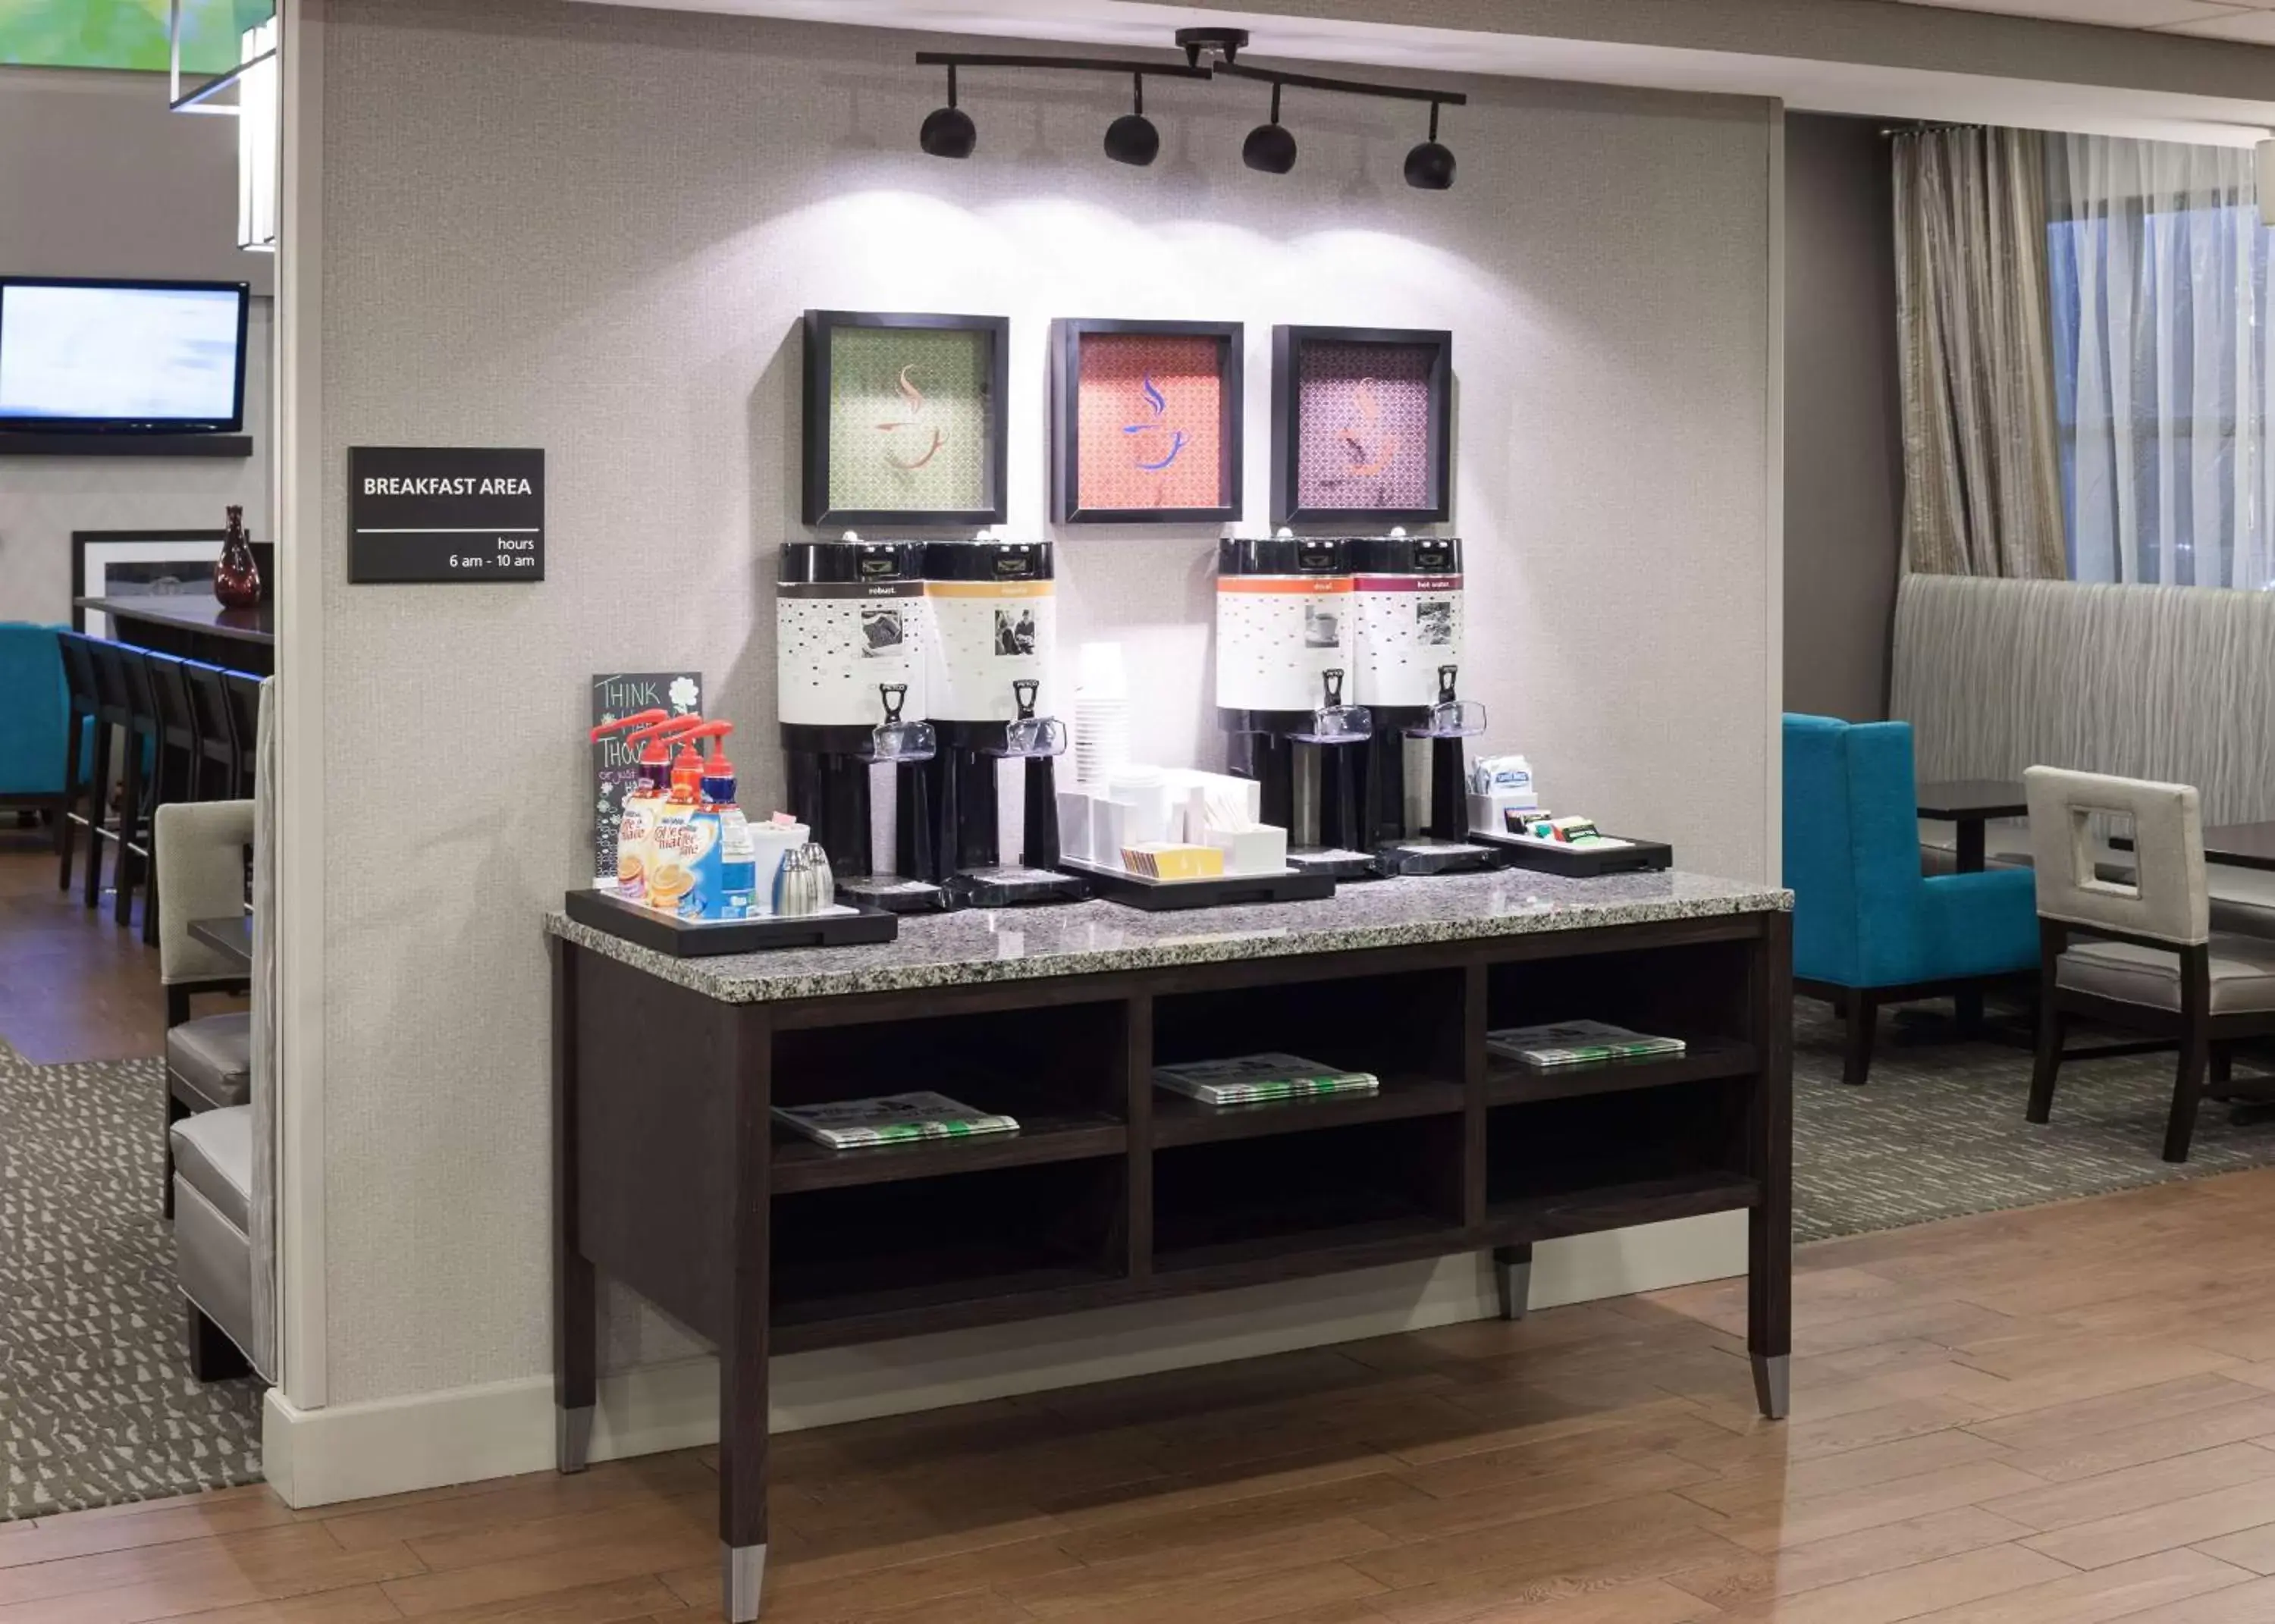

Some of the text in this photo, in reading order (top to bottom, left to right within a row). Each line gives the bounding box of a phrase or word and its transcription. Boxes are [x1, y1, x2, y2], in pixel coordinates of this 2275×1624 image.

[363, 478, 532, 495] BREAKFAST AREA
[497, 537, 535, 550] hours
[449, 554, 458, 567] 6
[461, 558, 483, 567] am
[497, 554, 510, 567] 10
[513, 558, 535, 567] am
[594, 675, 661, 708] THINK
